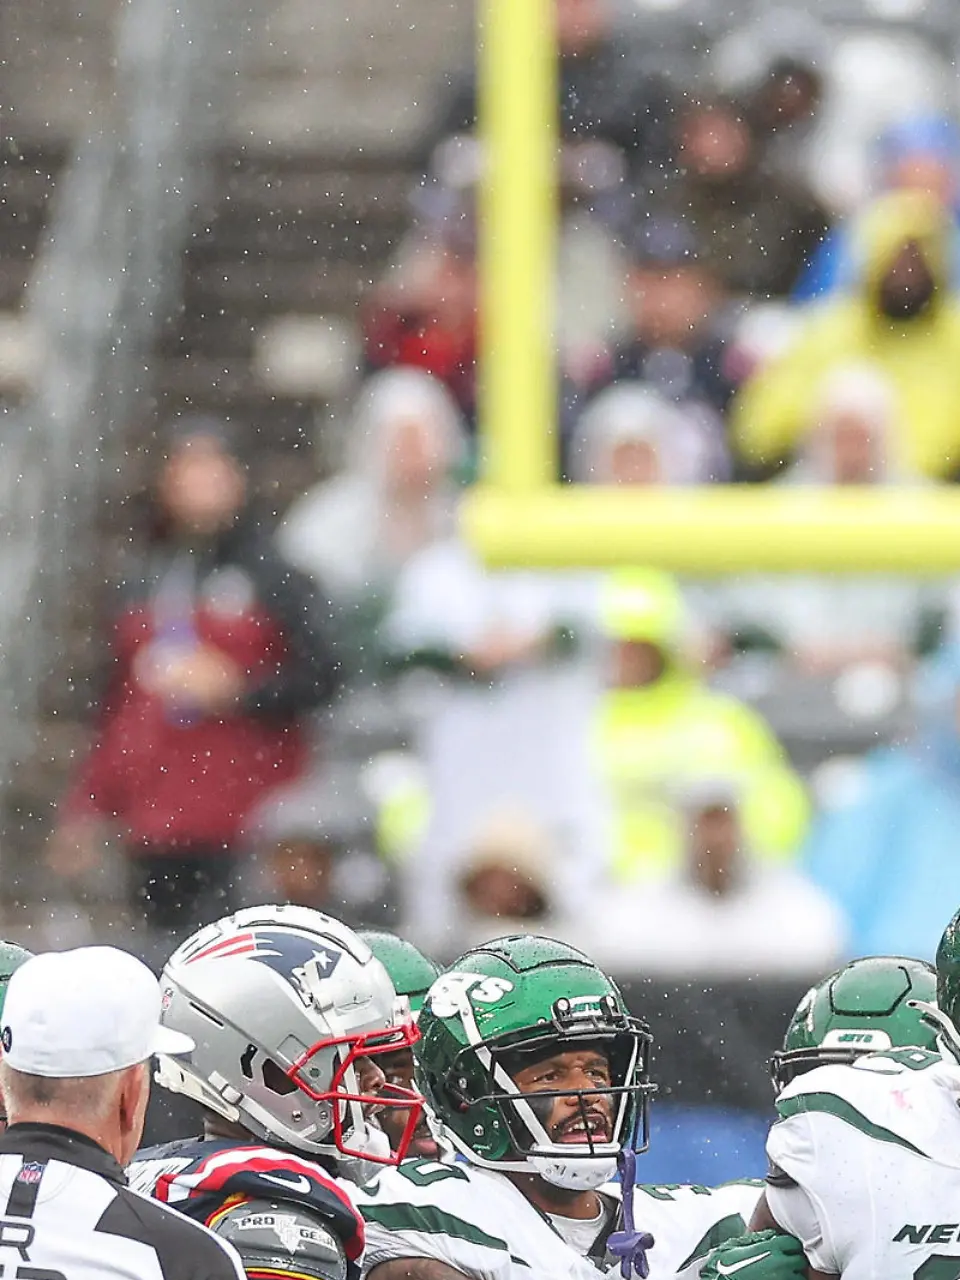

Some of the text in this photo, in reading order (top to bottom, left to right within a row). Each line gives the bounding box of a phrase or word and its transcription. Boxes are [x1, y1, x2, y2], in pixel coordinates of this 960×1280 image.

[0, 1221, 35, 1262] R
[241, 1216, 333, 1246] PRO GER
